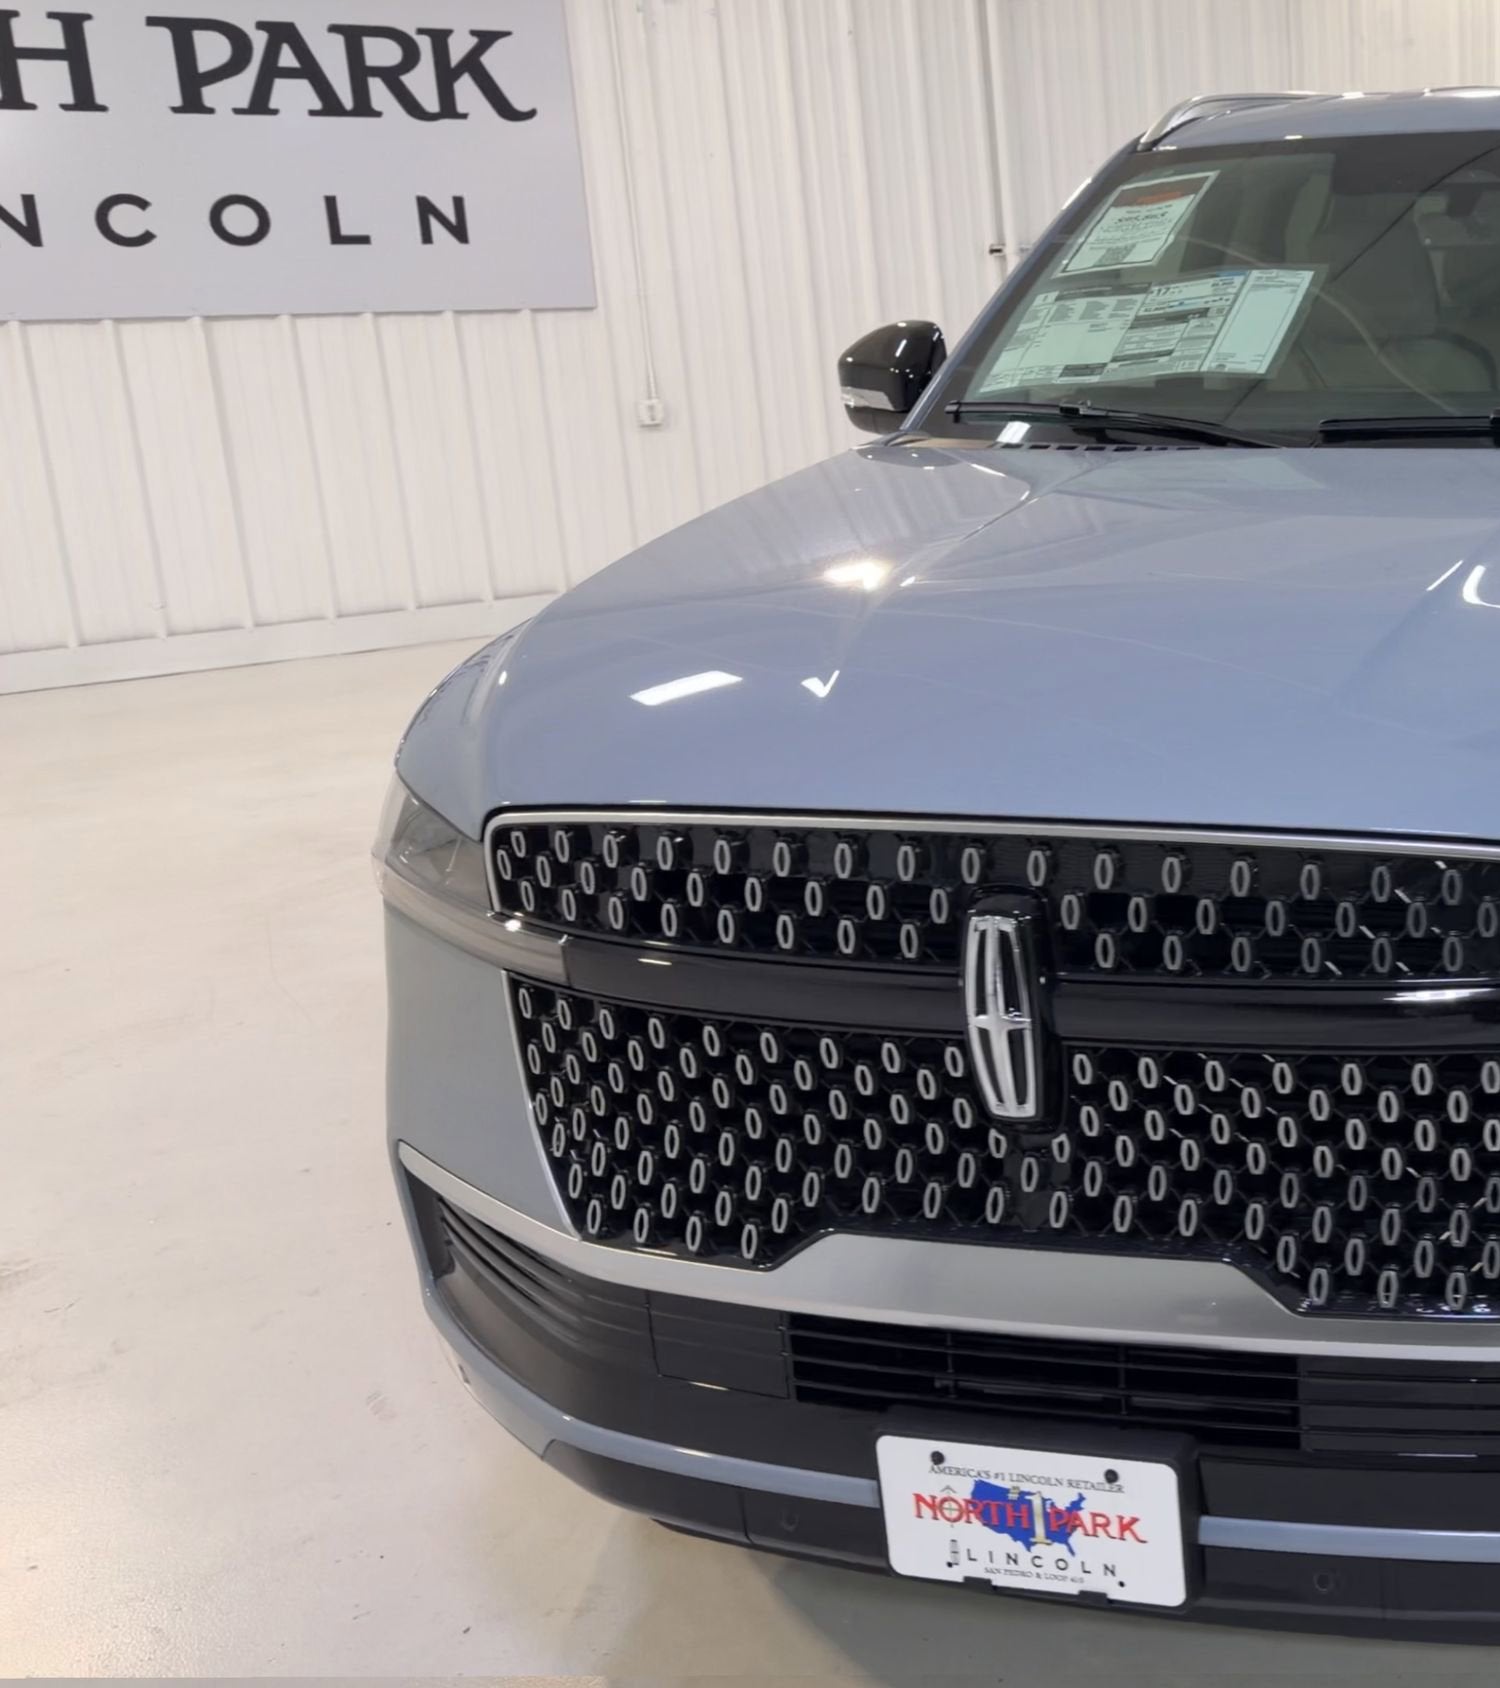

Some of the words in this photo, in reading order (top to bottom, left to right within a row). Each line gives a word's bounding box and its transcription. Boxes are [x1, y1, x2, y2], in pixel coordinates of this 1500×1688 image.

[0, 9, 109, 112] H
[145, 15, 538, 122] PARK
[1008, 1473, 1064, 1487] LINCOLN
[1065, 1479, 1125, 1494] RETAILER
[912, 1492, 1031, 1529] NORTH
[1048, 1505, 1148, 1544] PARK
[966, 1548, 1117, 1578] LINCOLN
